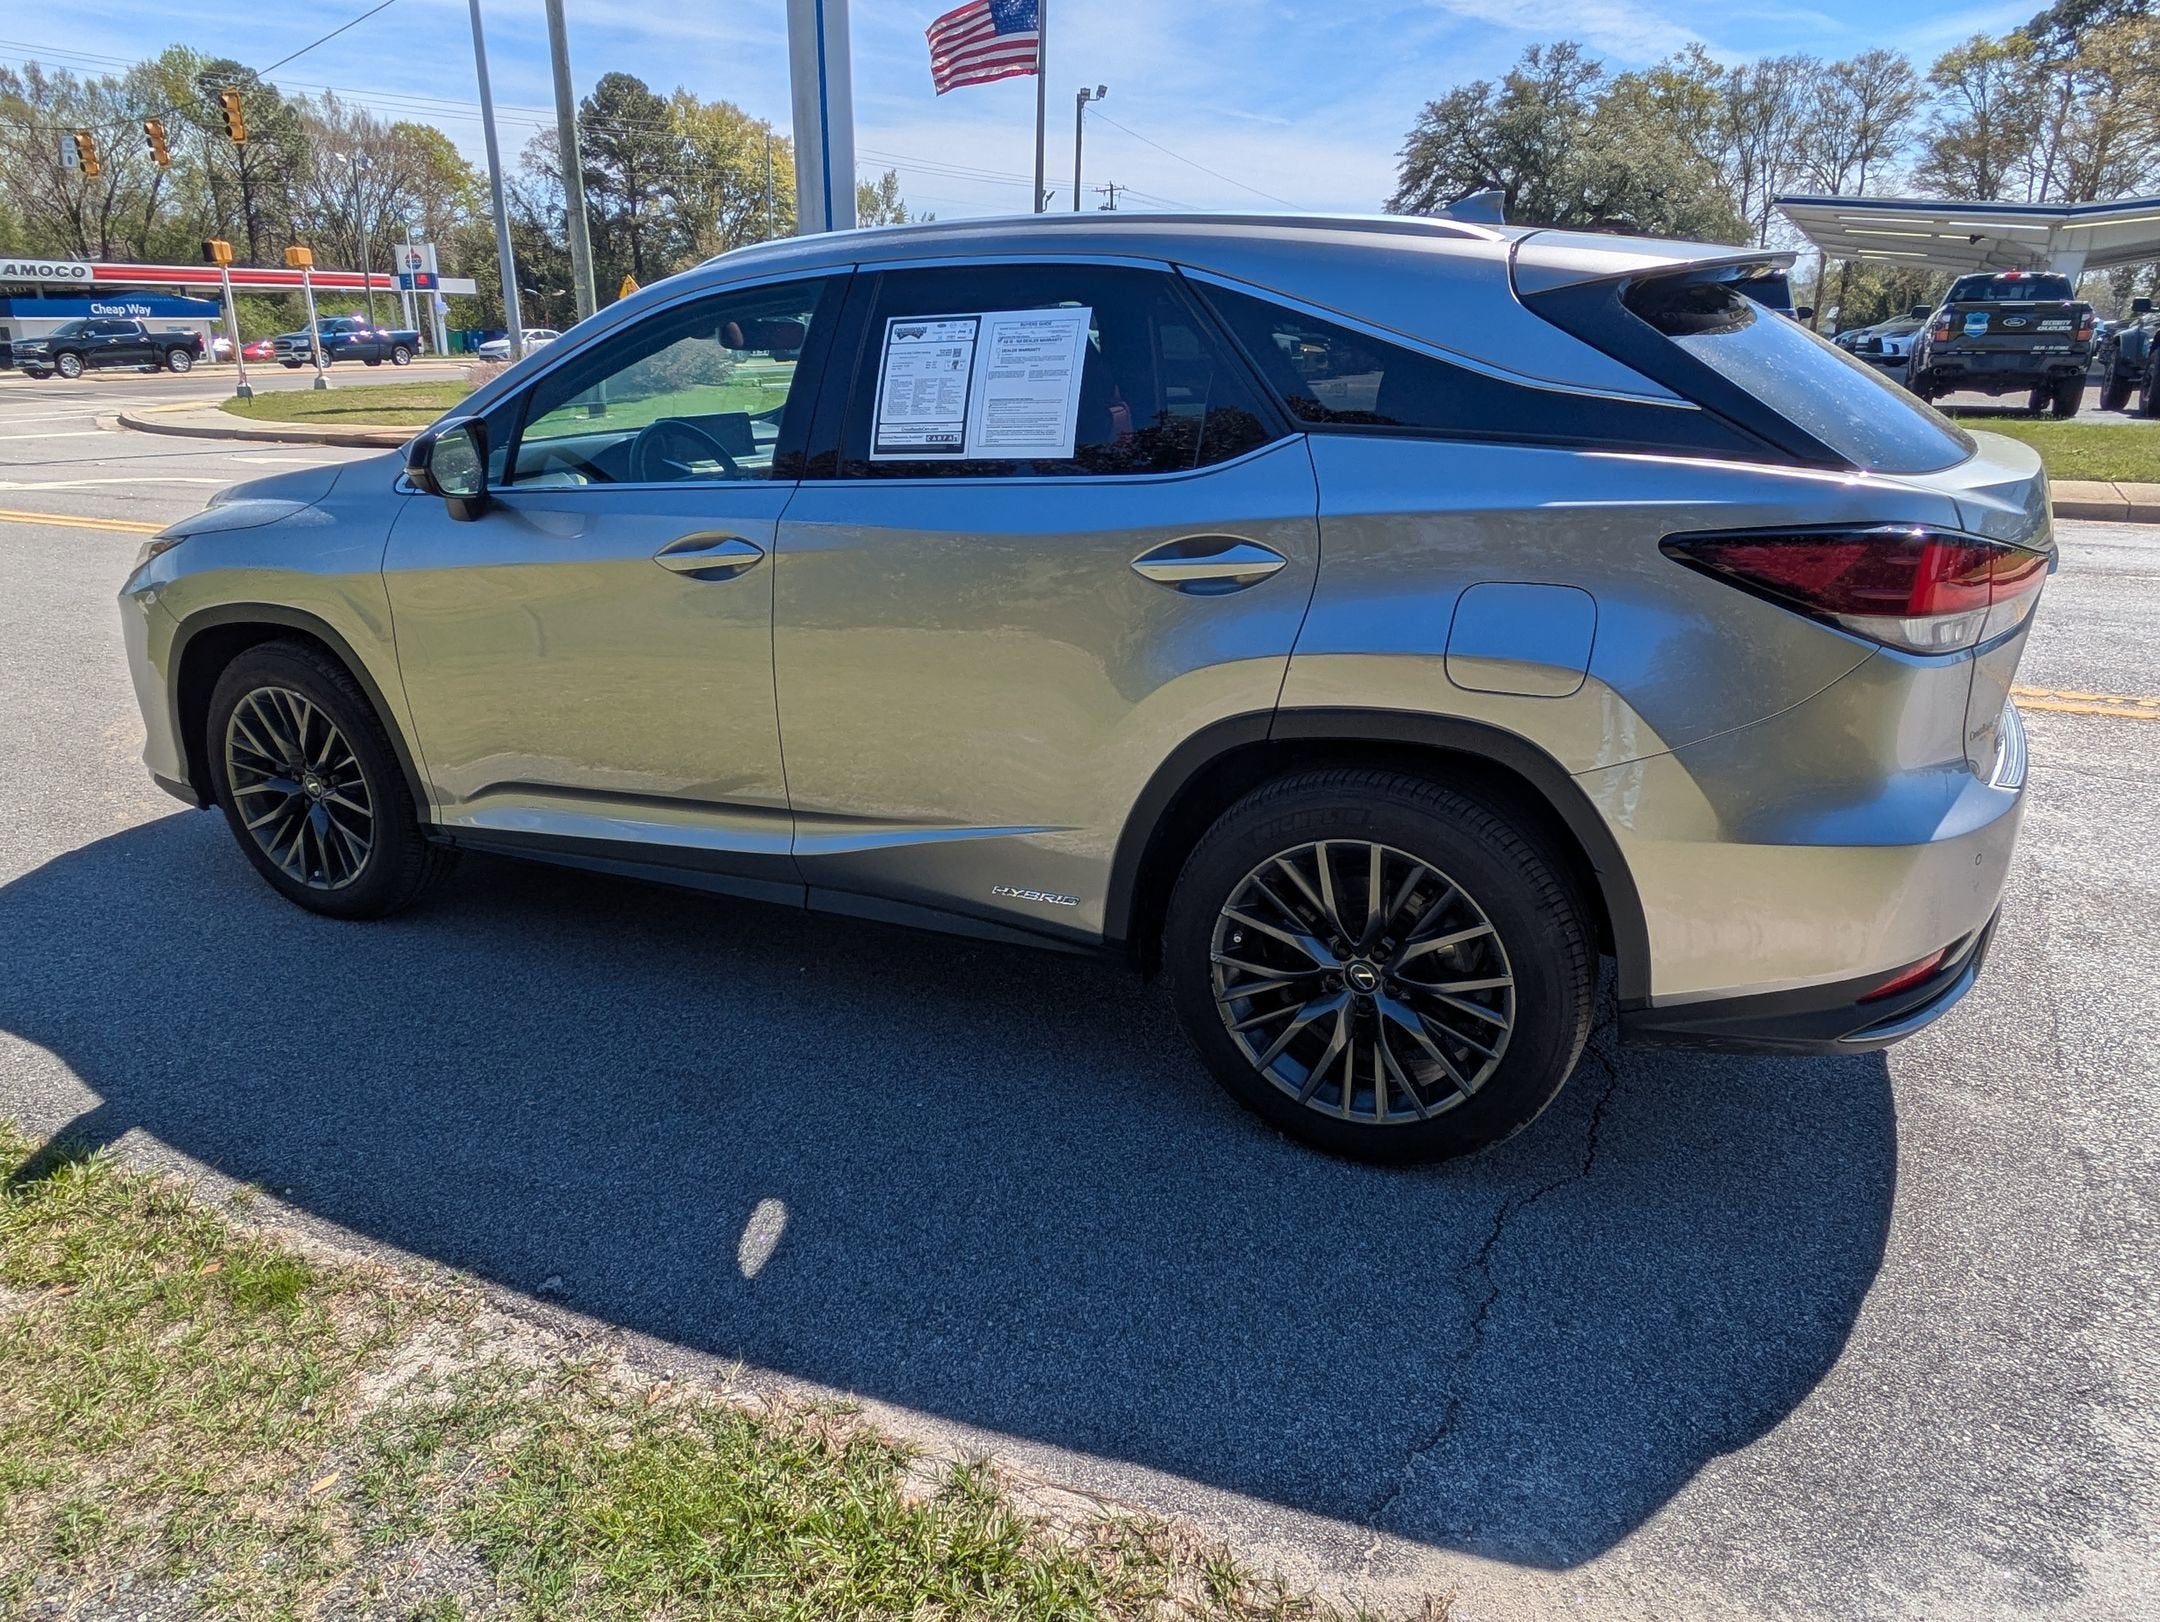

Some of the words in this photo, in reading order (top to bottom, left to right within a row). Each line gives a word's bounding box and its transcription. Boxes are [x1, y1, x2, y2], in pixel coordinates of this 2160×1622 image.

[3, 264, 86, 278] AMOCO
[90, 303, 126, 317] Cheap
[127, 303, 151, 317] Way
[991, 884, 1081, 907] HYBRID
